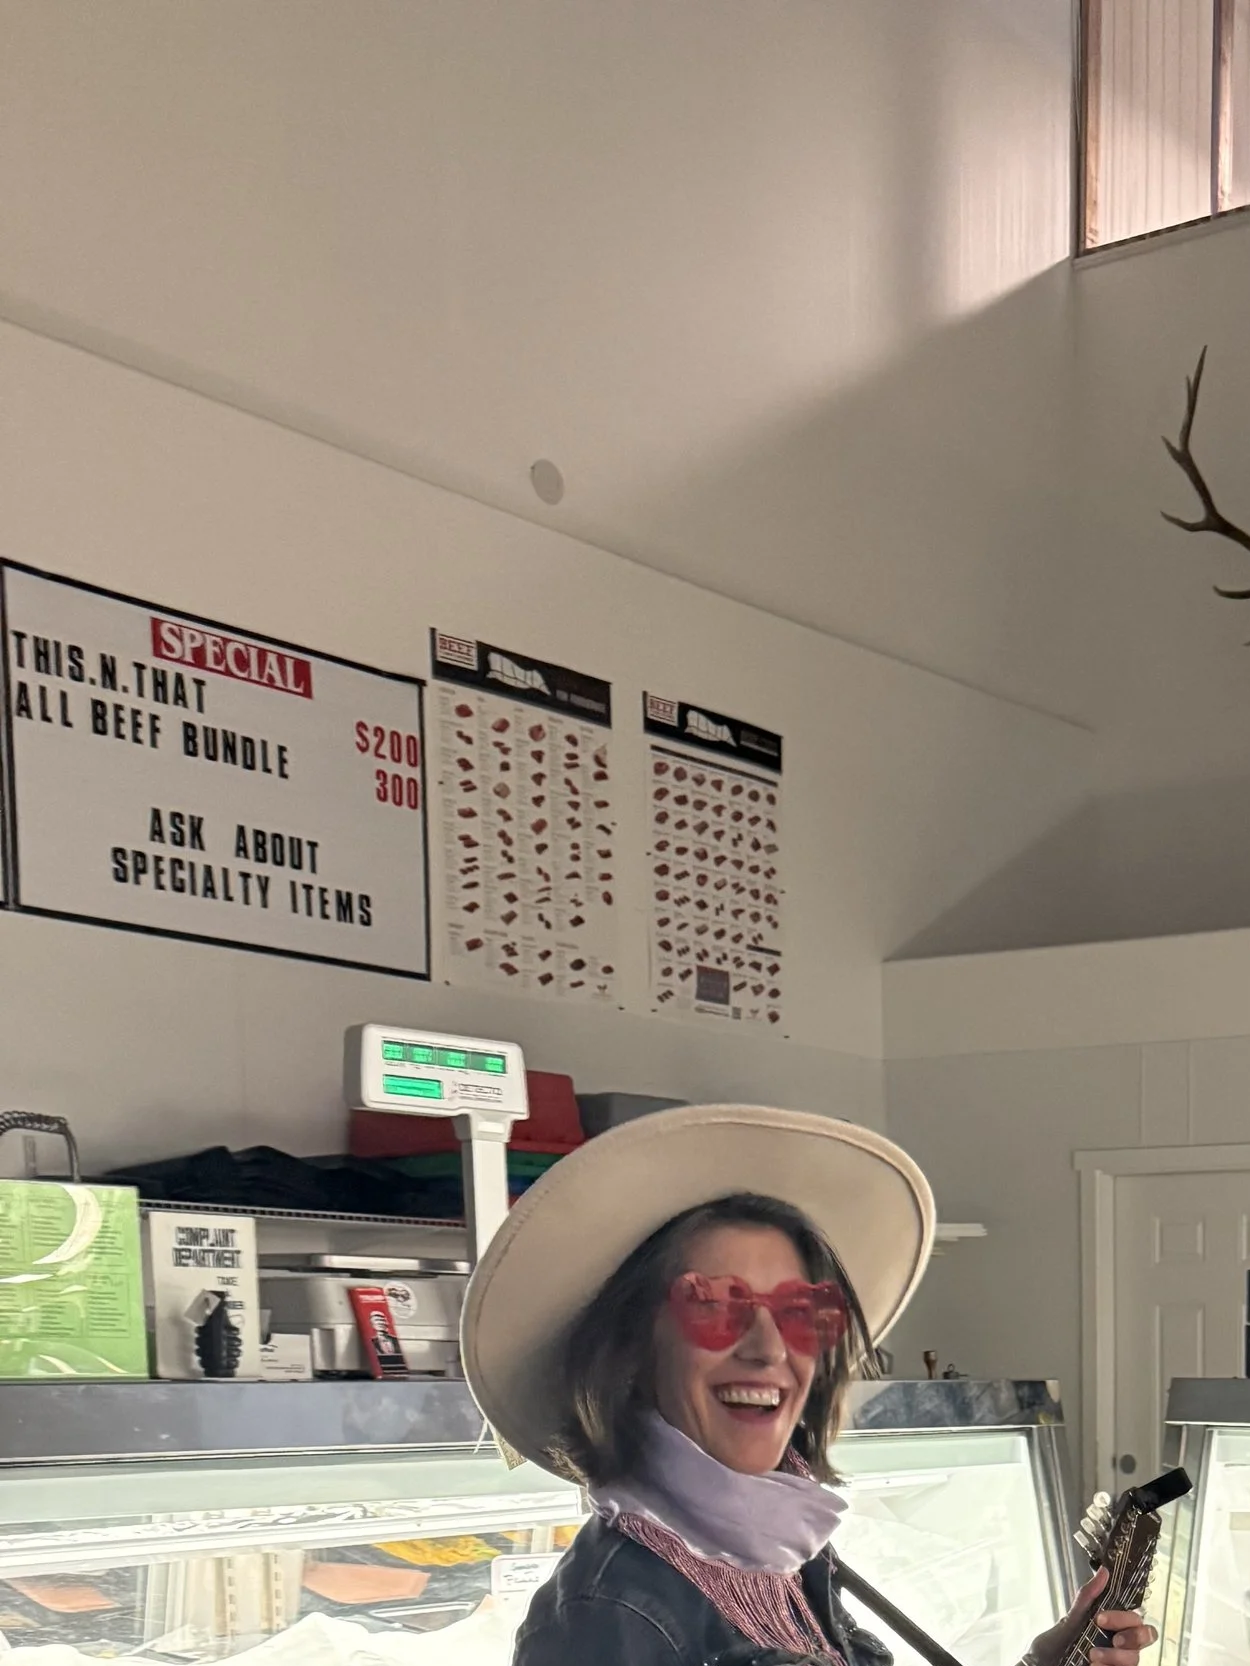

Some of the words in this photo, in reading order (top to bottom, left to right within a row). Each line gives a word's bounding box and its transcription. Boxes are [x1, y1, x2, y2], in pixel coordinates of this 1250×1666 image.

[158, 620, 306, 695] SPECIAL
[15, 681, 74, 728] ALL
[90, 697, 162, 750] BEEF
[182, 720, 290, 780] BUNDLE
[375, 769, 420, 811] 300
[354, 720, 420, 769] $200
[149, 806, 206, 852] ASK
[234, 824, 320, 875] ABOUT
[110, 846, 272, 909] SPECIALTY
[289, 880, 373, 927] ITEMS
[171, 1247, 242, 1269] DEPARTMENT
[175, 1226, 237, 1248] COMPLAINT
